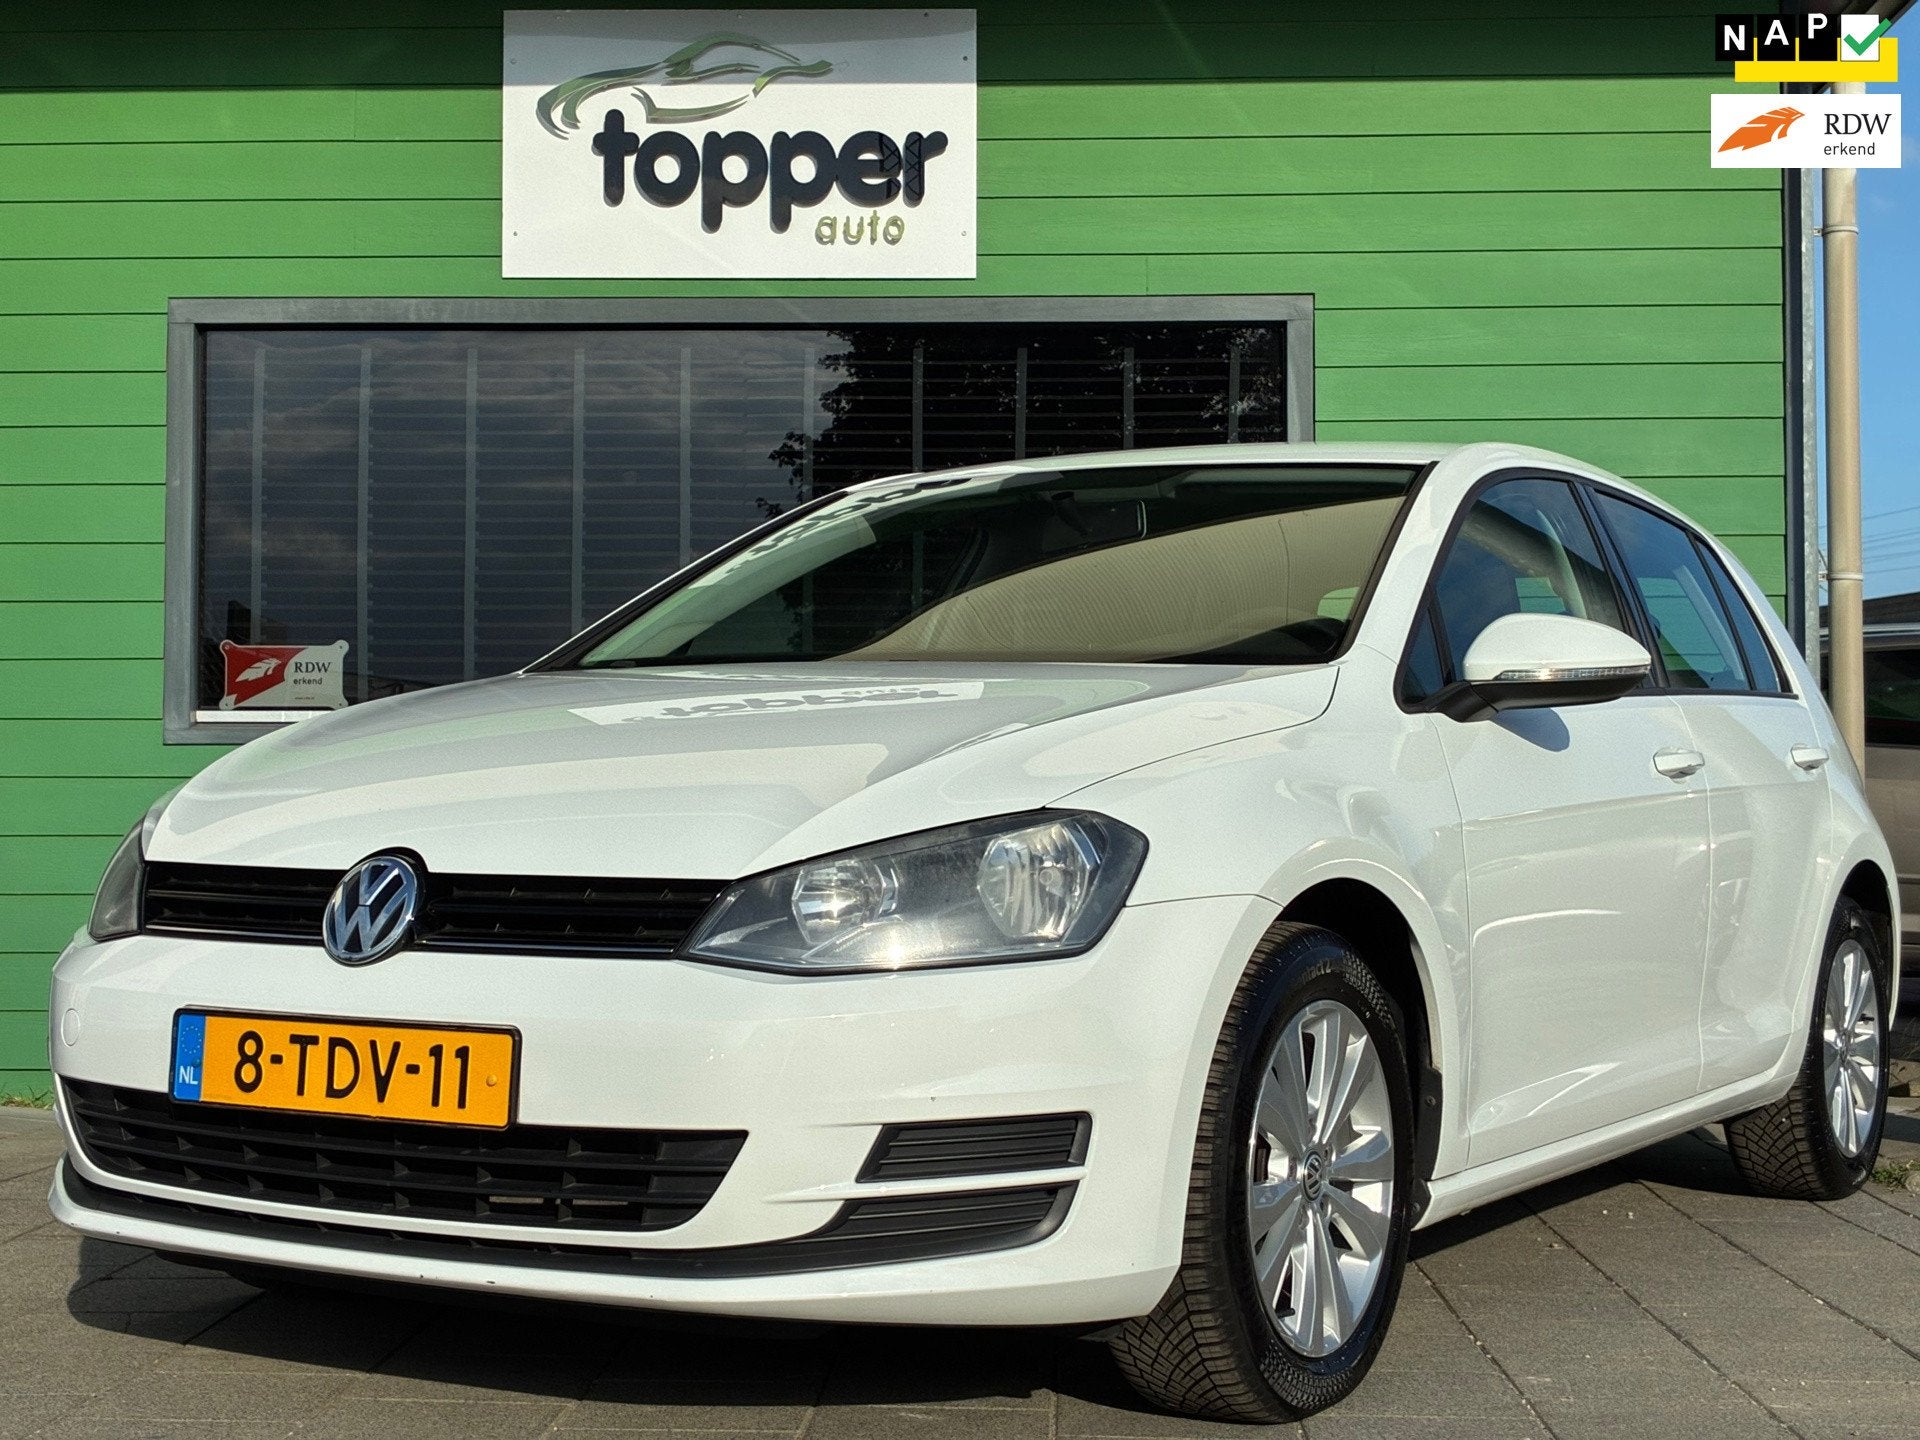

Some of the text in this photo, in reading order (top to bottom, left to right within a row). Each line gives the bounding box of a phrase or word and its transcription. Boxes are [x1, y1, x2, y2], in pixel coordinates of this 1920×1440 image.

[592, 109, 949, 234] topper
[815, 210, 905, 246] auto
[294, 661, 331, 673] RDW
[293, 677, 323, 686] erkend
[178, 1065, 199, 1085] NL
[233, 1029, 471, 1110] 8-TDV-11
